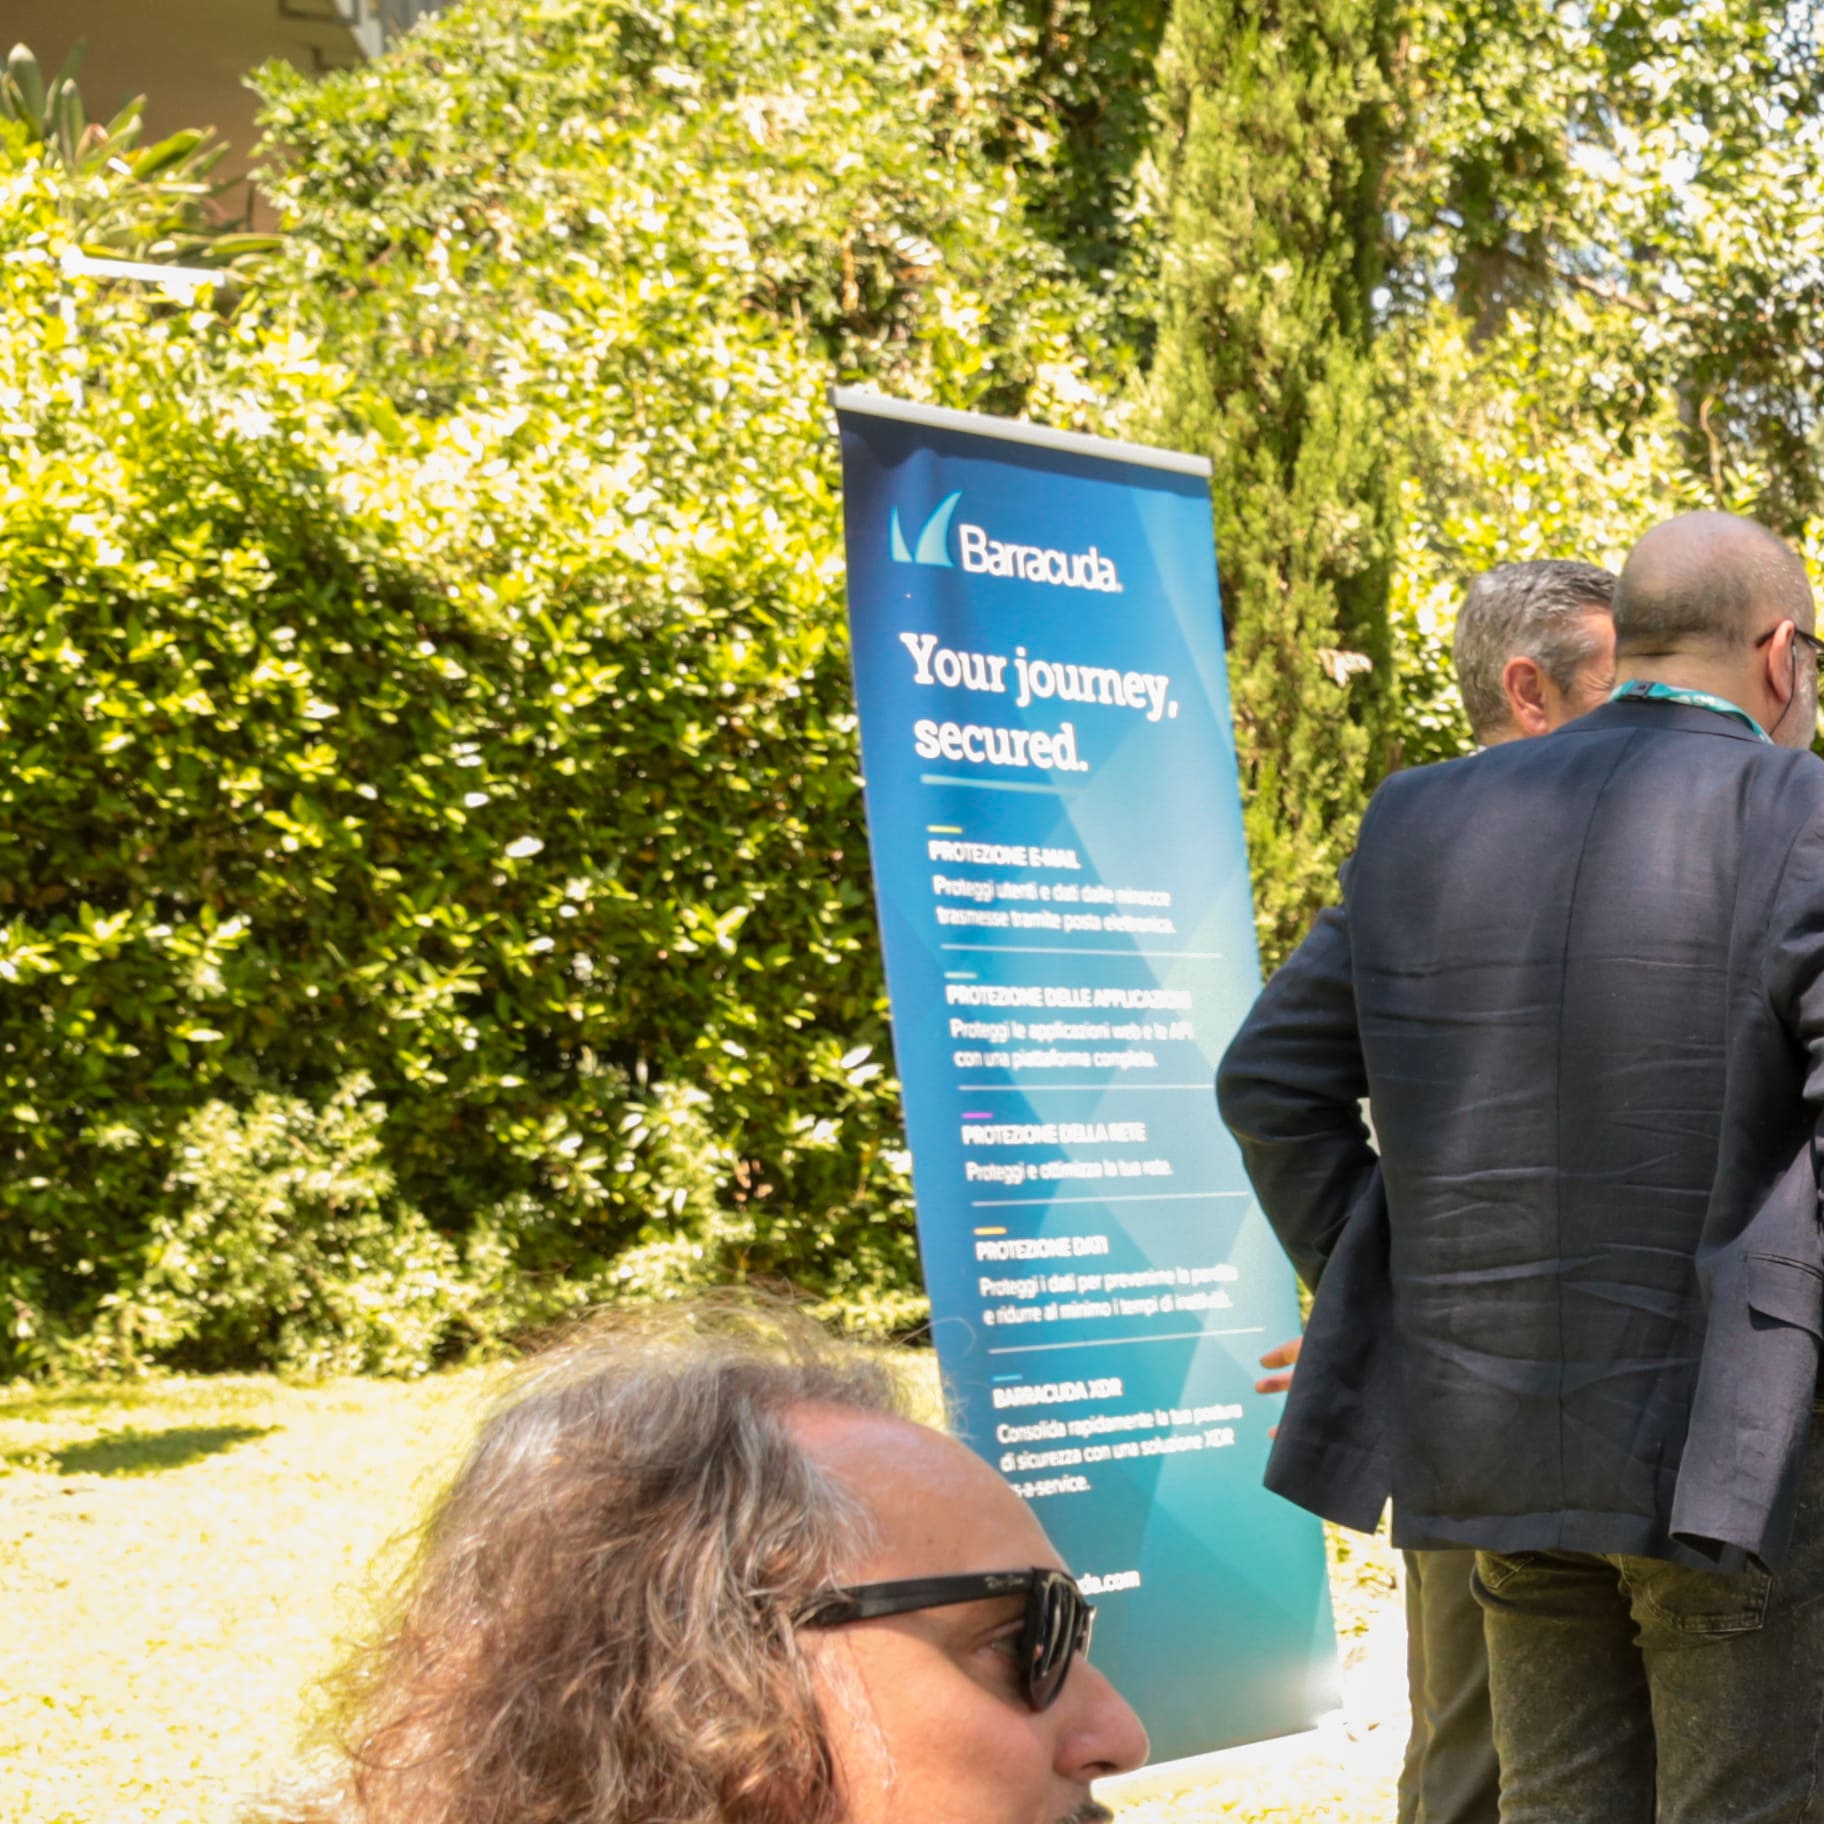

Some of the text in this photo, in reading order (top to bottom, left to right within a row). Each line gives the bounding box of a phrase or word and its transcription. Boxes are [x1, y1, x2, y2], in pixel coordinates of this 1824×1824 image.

[900, 632, 1179, 720] Your journey,
[914, 719, 1088, 770] secured.
[928, 840, 1027, 867] PROTEZIONE
[932, 875, 994, 902] Proteggi
[946, 985, 1043, 1007] PROTEZIONE
[950, 1018, 1010, 1043] Proteggi
[961, 1124, 1058, 1144] PROTEZIONE
[966, 1161, 1025, 1185] Proteggi
[1026, 1165, 1038, 1179] e
[975, 1235, 1109, 1261] PROTEZIONE DATI
[979, 1276, 1038, 1299] Proteggi
[1077, 1275, 1102, 1294] per
[983, 1308, 995, 1325] e
[1044, 1302, 1058, 1321] al
[992, 1377, 1122, 1408] BARRACUDA XDR
[997, 1420, 1067, 1444] Consolida
[1068, 1411, 1154, 1438] rapidamente
[1155, 1408, 1168, 1426] la
[1169, 1407, 1192, 1425] tua
[1001, 1427, 1235, 1472] di sicurezza con una soluzione XDR
